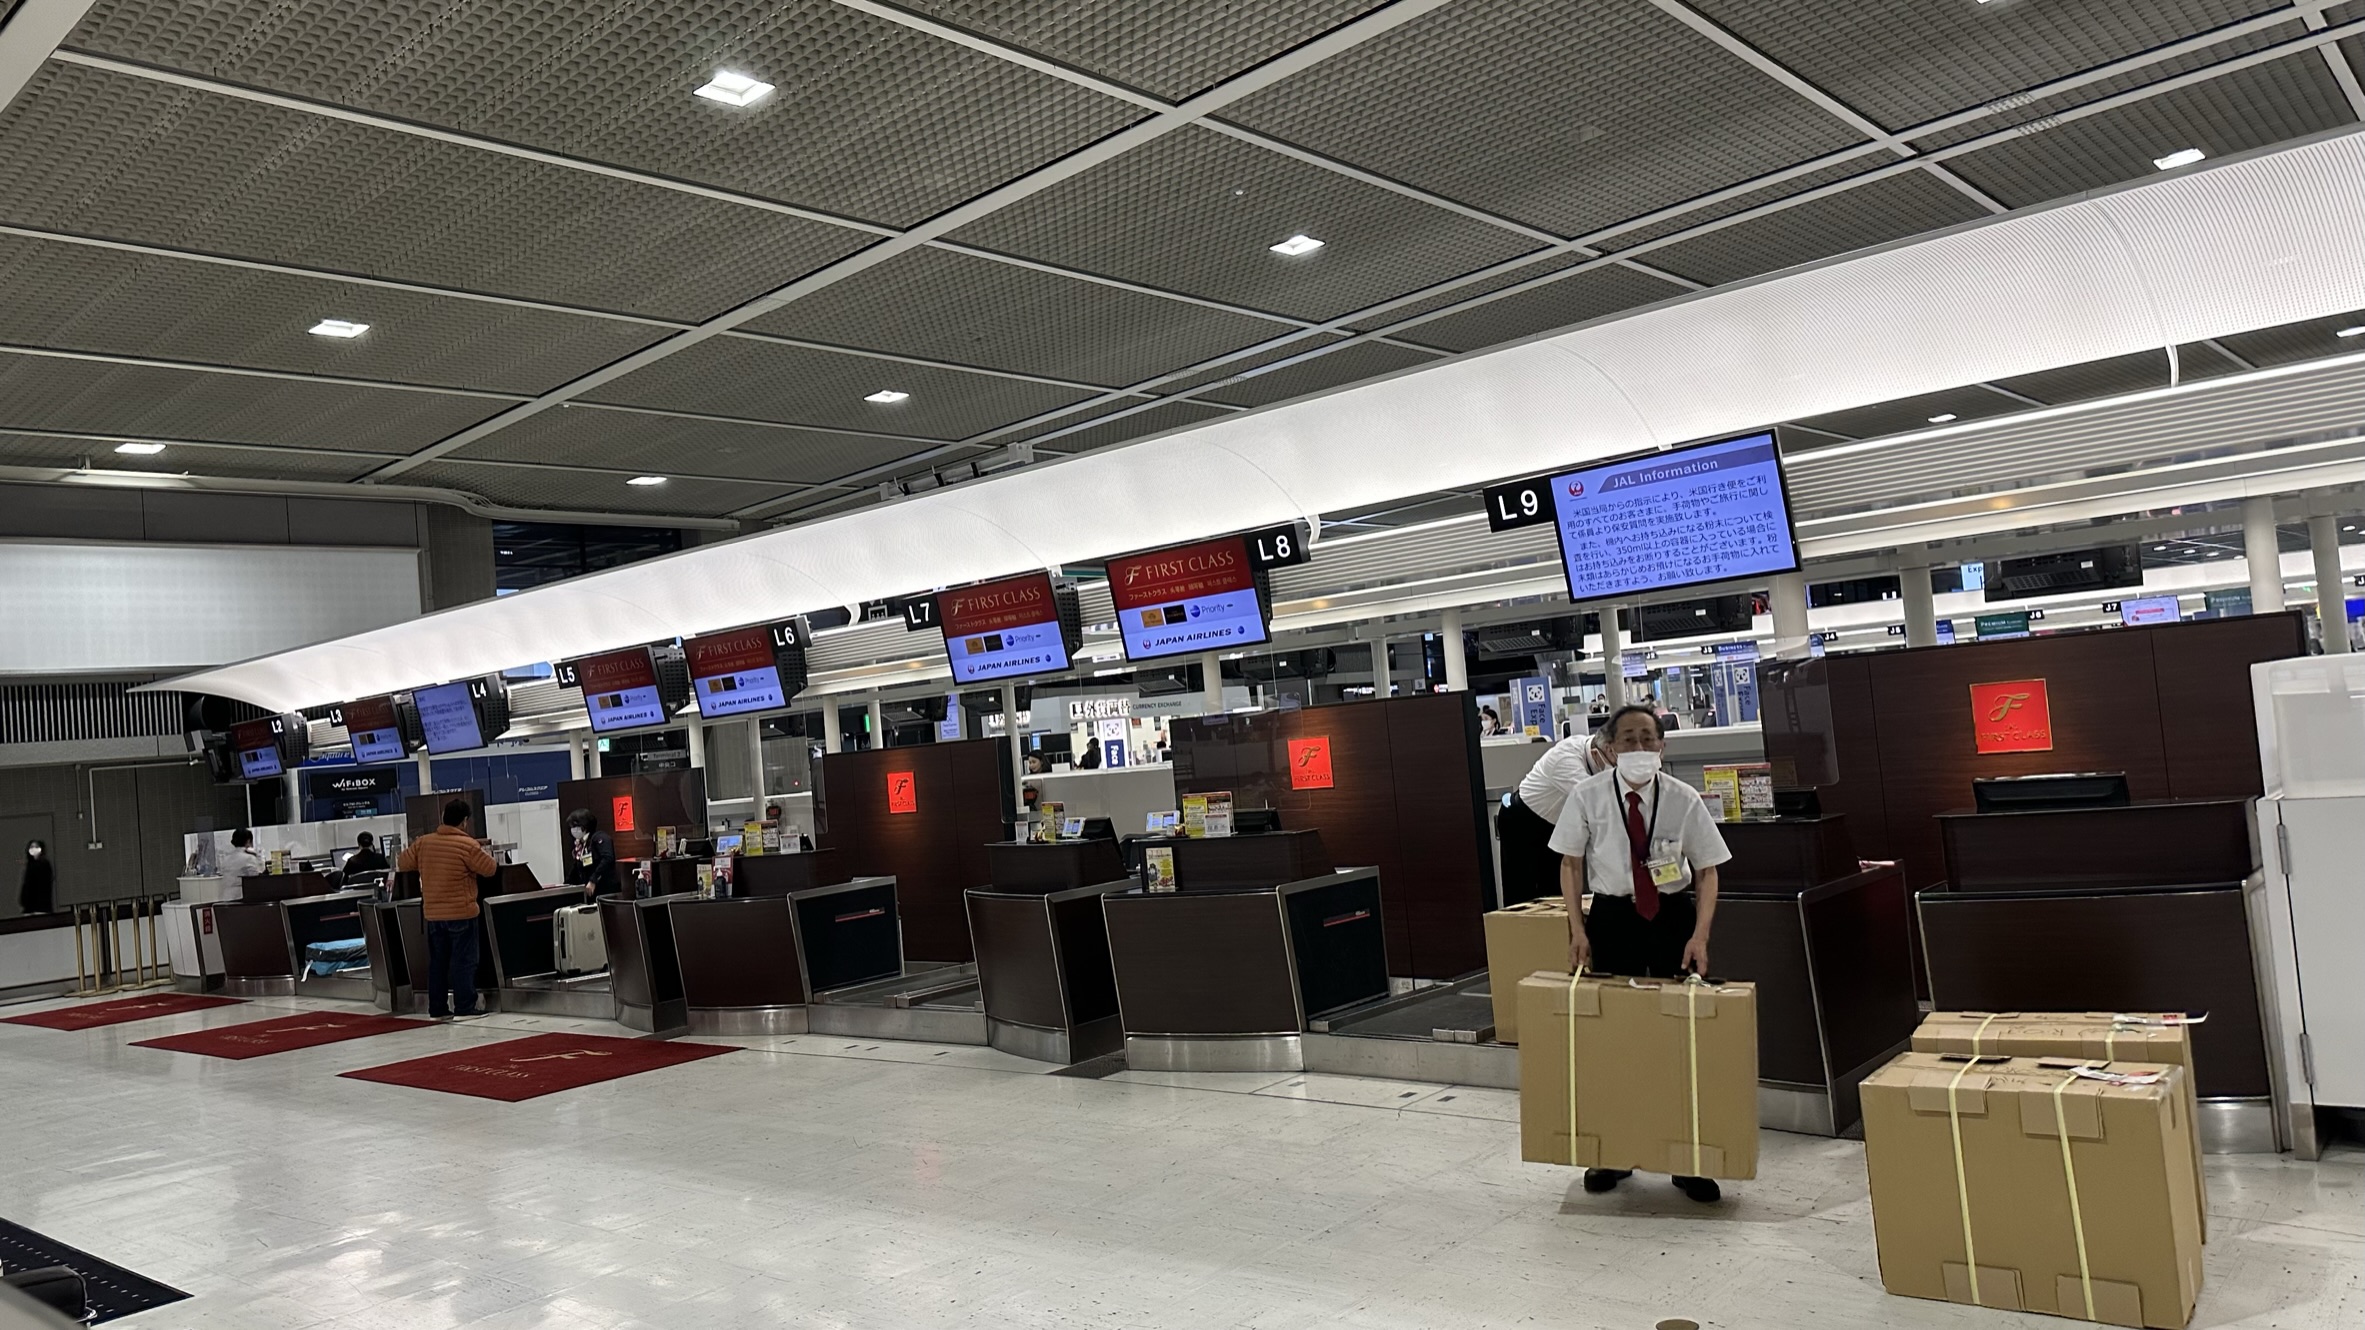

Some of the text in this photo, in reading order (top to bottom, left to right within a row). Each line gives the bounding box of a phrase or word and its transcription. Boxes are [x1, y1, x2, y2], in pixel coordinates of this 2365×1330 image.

[1613, 462, 1719, 488] JAL Information
[1497, 489, 1539, 521] L9
[1257, 535, 1291, 562] L8
[1146, 559, 1184, 580] FIRST
[1188, 550, 1235, 572] CLASS
[968, 594, 1000, 612] FIRST
[1003, 587, 1041, 604] CLASS
[1128, 588, 1168, 601] ファーストクラス
[908, 602, 930, 624] L7
[1201, 602, 1226, 615] Priority
[2105, 602, 2118, 612] J7
[774, 626, 795, 647] L6
[1154, 628, 1232, 647] JAPAN AIRLINES
[708, 642, 733, 657] FIRST
[734, 637, 762, 652] CLASS
[597, 663, 619, 676] FIRST
[620, 659, 645, 671] CLASS
[977, 656, 1041, 672] JAPAN AIRLINES
[558, 666, 576, 684] L5
[472, 682, 487, 699] L4
[718, 695, 765, 708] JAPAN AIRLINES
[330, 708, 343, 724] L3
[1537, 703, 1546, 724] Face
[271, 720, 283, 733] L2
[2012, 728, 2047, 741] CLASS
[1110, 745, 1120, 766] Face
